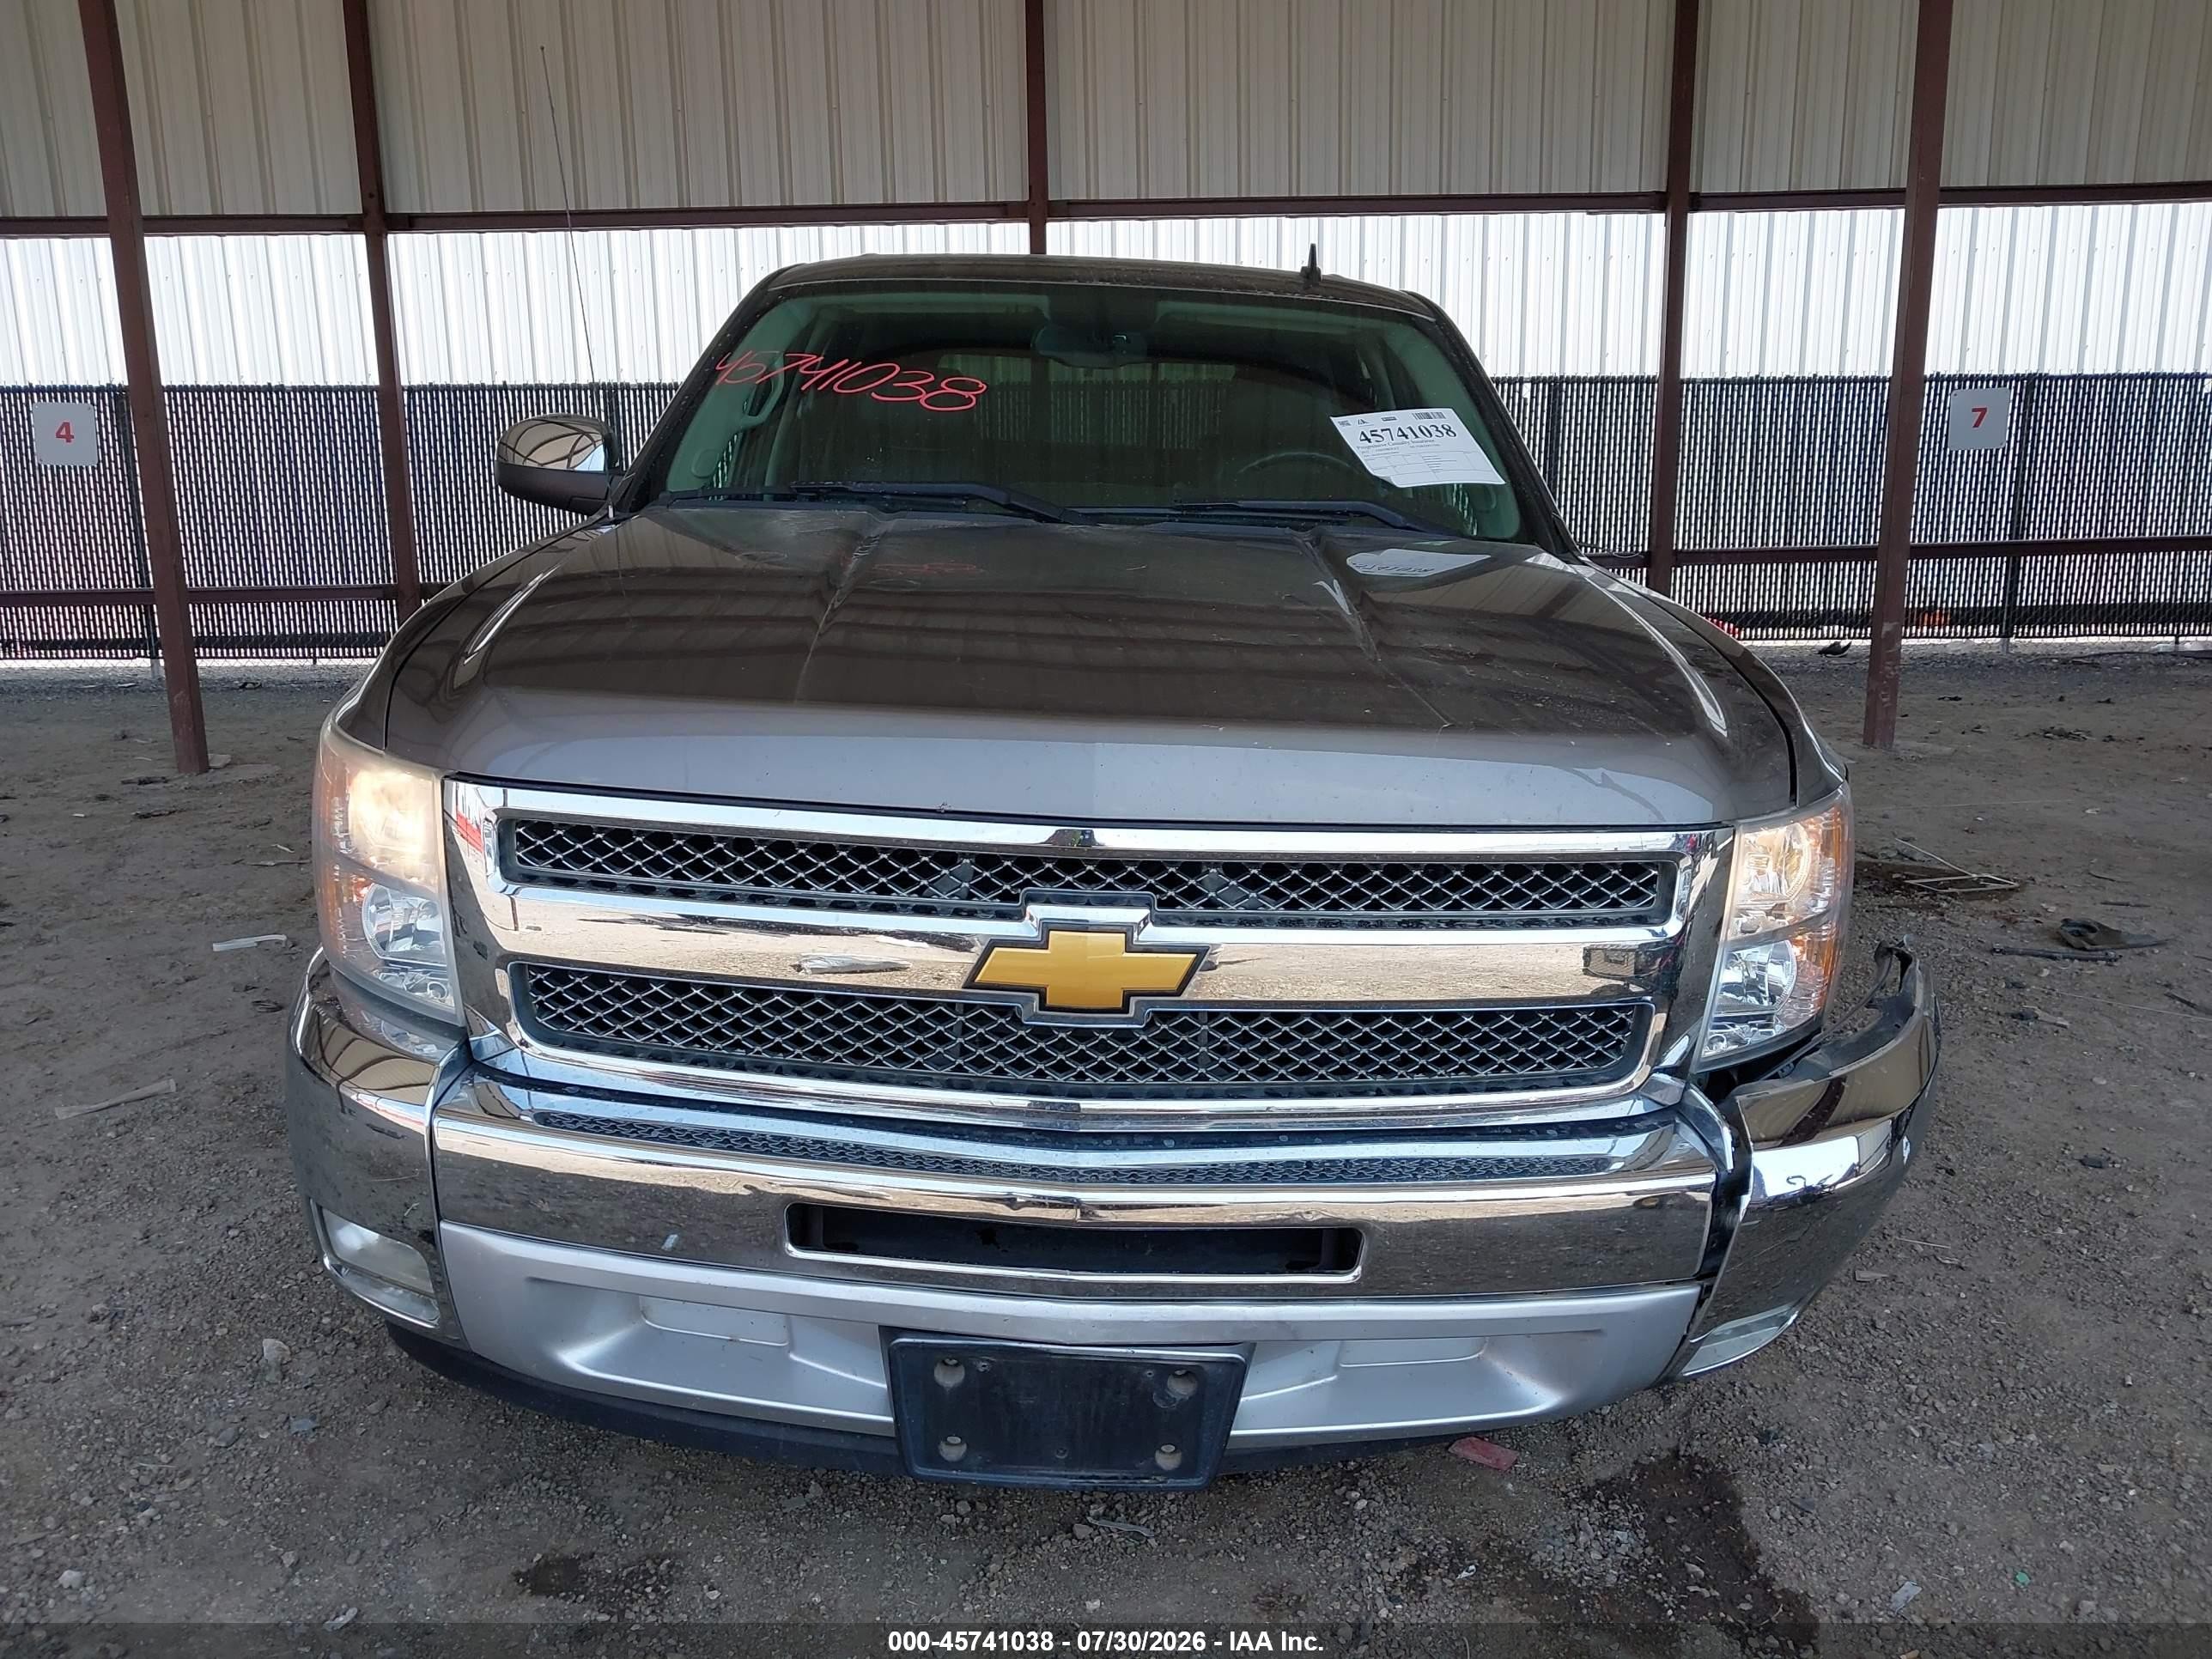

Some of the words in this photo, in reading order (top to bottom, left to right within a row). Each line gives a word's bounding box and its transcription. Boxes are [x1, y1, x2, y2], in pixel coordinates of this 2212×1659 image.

[714, 349, 988, 411] 45741038
[1971, 406, 1988, 428] 7
[54, 421, 75, 443] 4
[1359, 423, 1457, 444] 45741038
